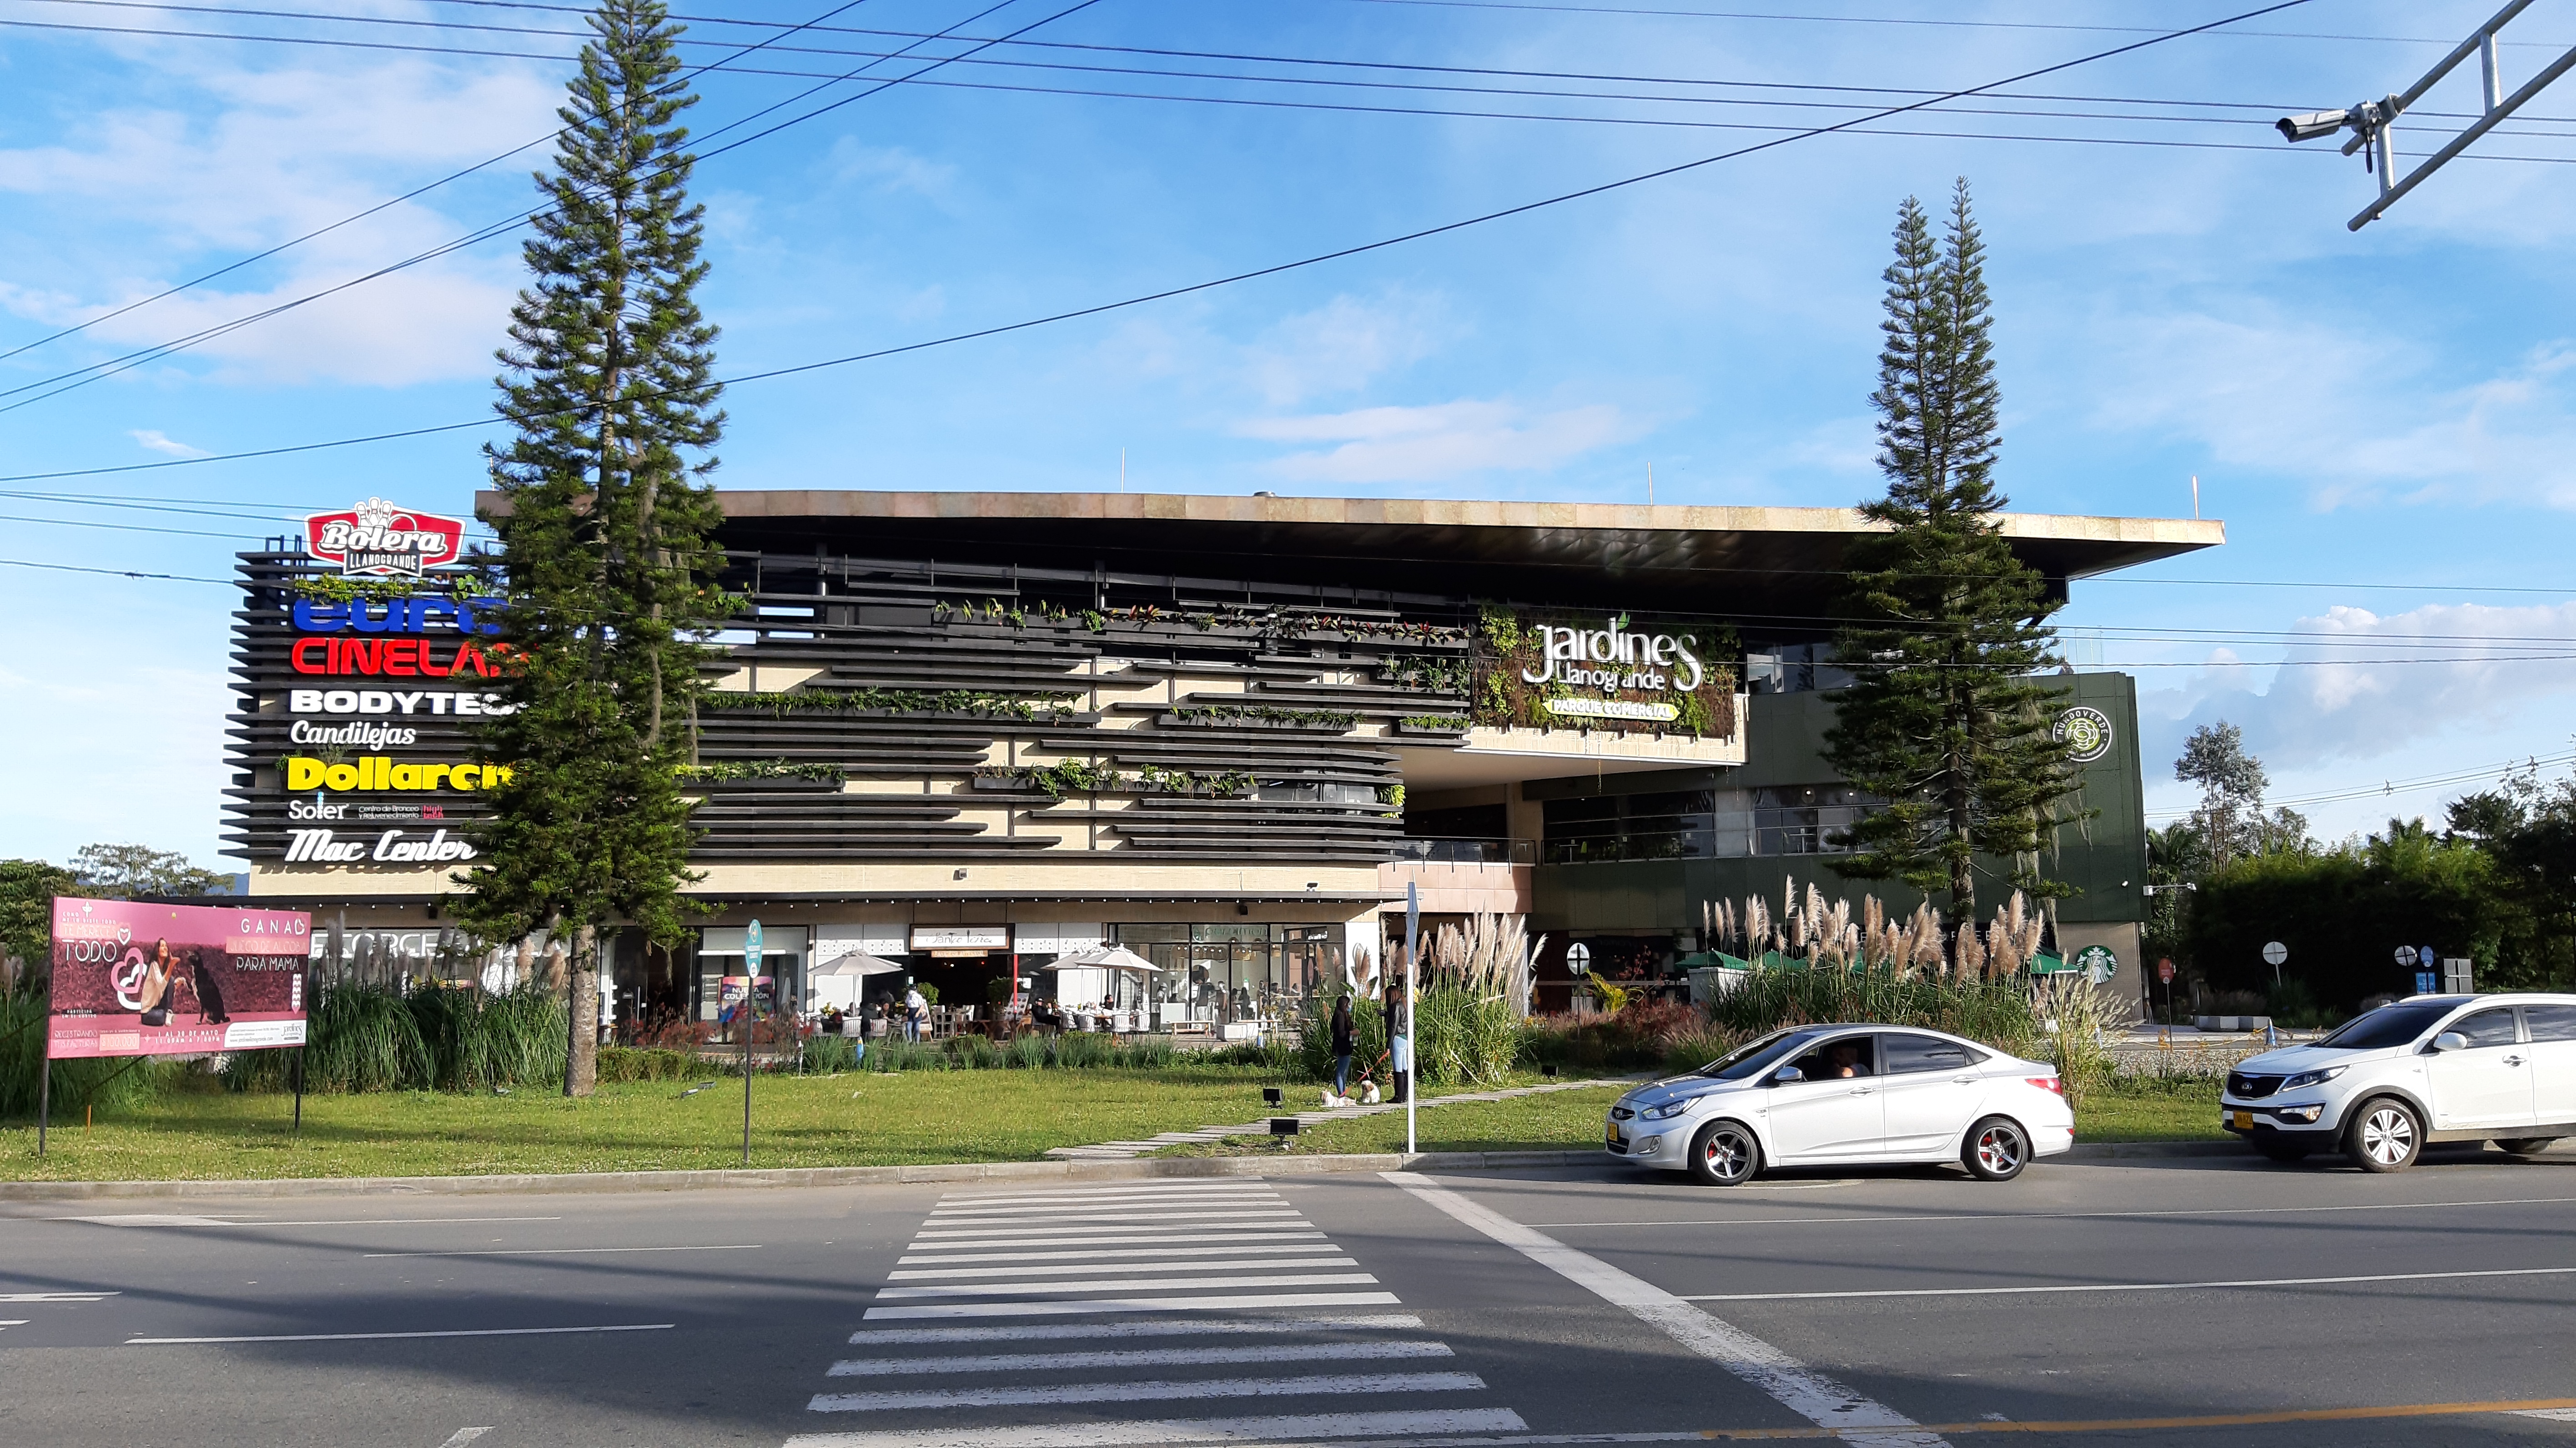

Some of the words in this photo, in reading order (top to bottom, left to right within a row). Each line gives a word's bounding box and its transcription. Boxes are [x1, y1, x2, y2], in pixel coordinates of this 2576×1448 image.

[318, 523, 448, 552] Bolera
[350, 553, 417, 571] LLANOGRANDE
[1522, 617, 1702, 692] Jardines
[1554, 699, 1603, 714] PARQUE
[1603, 701, 1671, 717] COMERCIAL
[290, 720, 416, 750] Candilejas
[288, 792, 347, 820] Soler
[285, 830, 366, 861] Mac
[373, 830, 478, 862] Center
[62, 939, 116, 962] TODO
[236, 957, 267, 971] PARA
